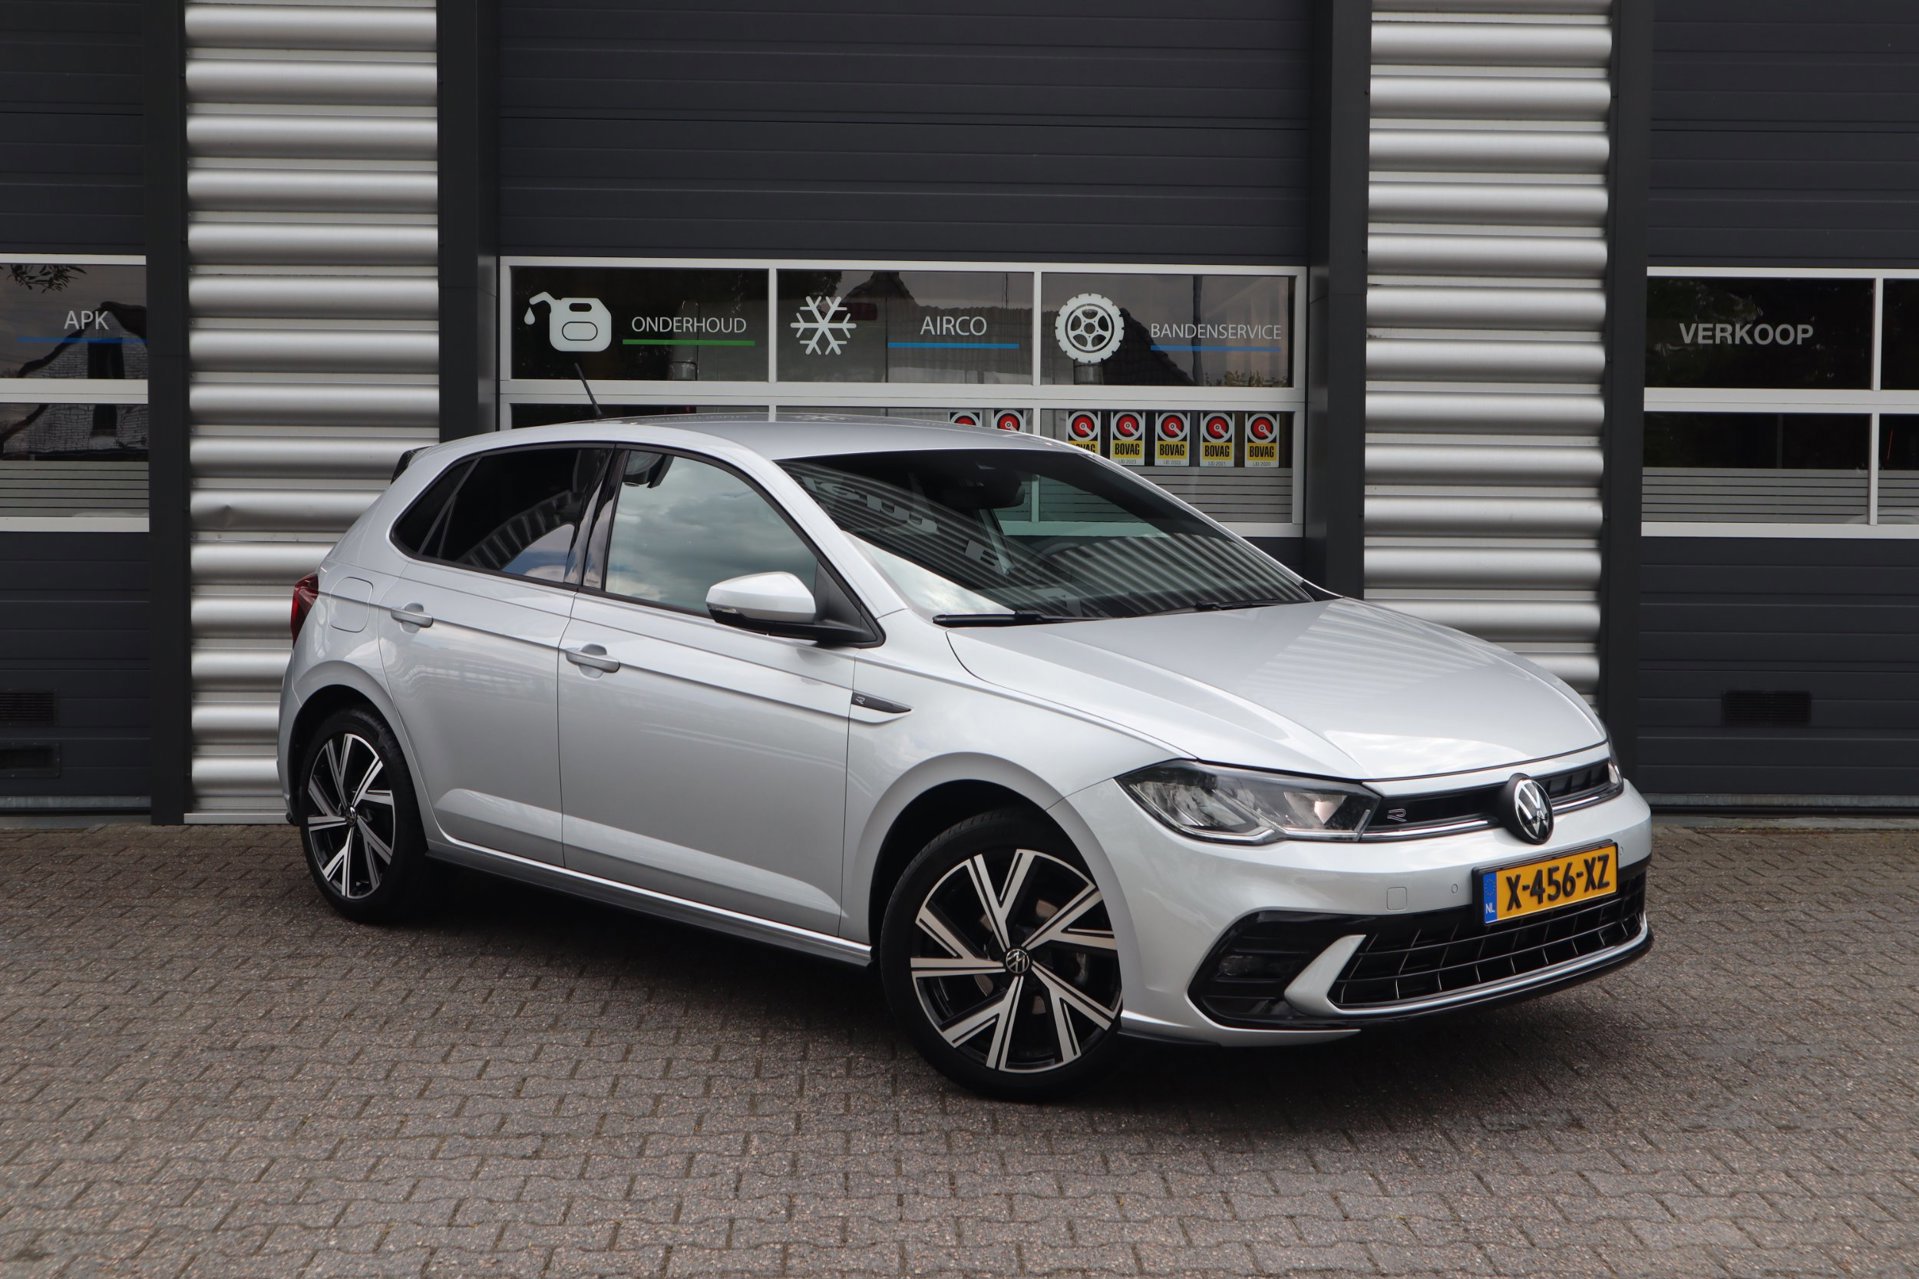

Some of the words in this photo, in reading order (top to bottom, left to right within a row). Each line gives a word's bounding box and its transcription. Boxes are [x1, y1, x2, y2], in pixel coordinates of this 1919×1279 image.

[64, 310, 110, 330] APK
[631, 316, 747, 333] ONDERHOUD
[920, 316, 988, 336] AIRCO
[1150, 323, 1282, 340] BANDENSERVICE
[1679, 323, 1814, 345] VERKOOP
[1114, 443, 1140, 456] BOVAG
[1159, 444, 1185, 457] BOVAG
[1204, 445, 1230, 458] BOVAG
[1249, 446, 1275, 458] BOVAG
[1505, 854, 1610, 912] X-456-XZ
[1485, 904, 1496, 914] NL
